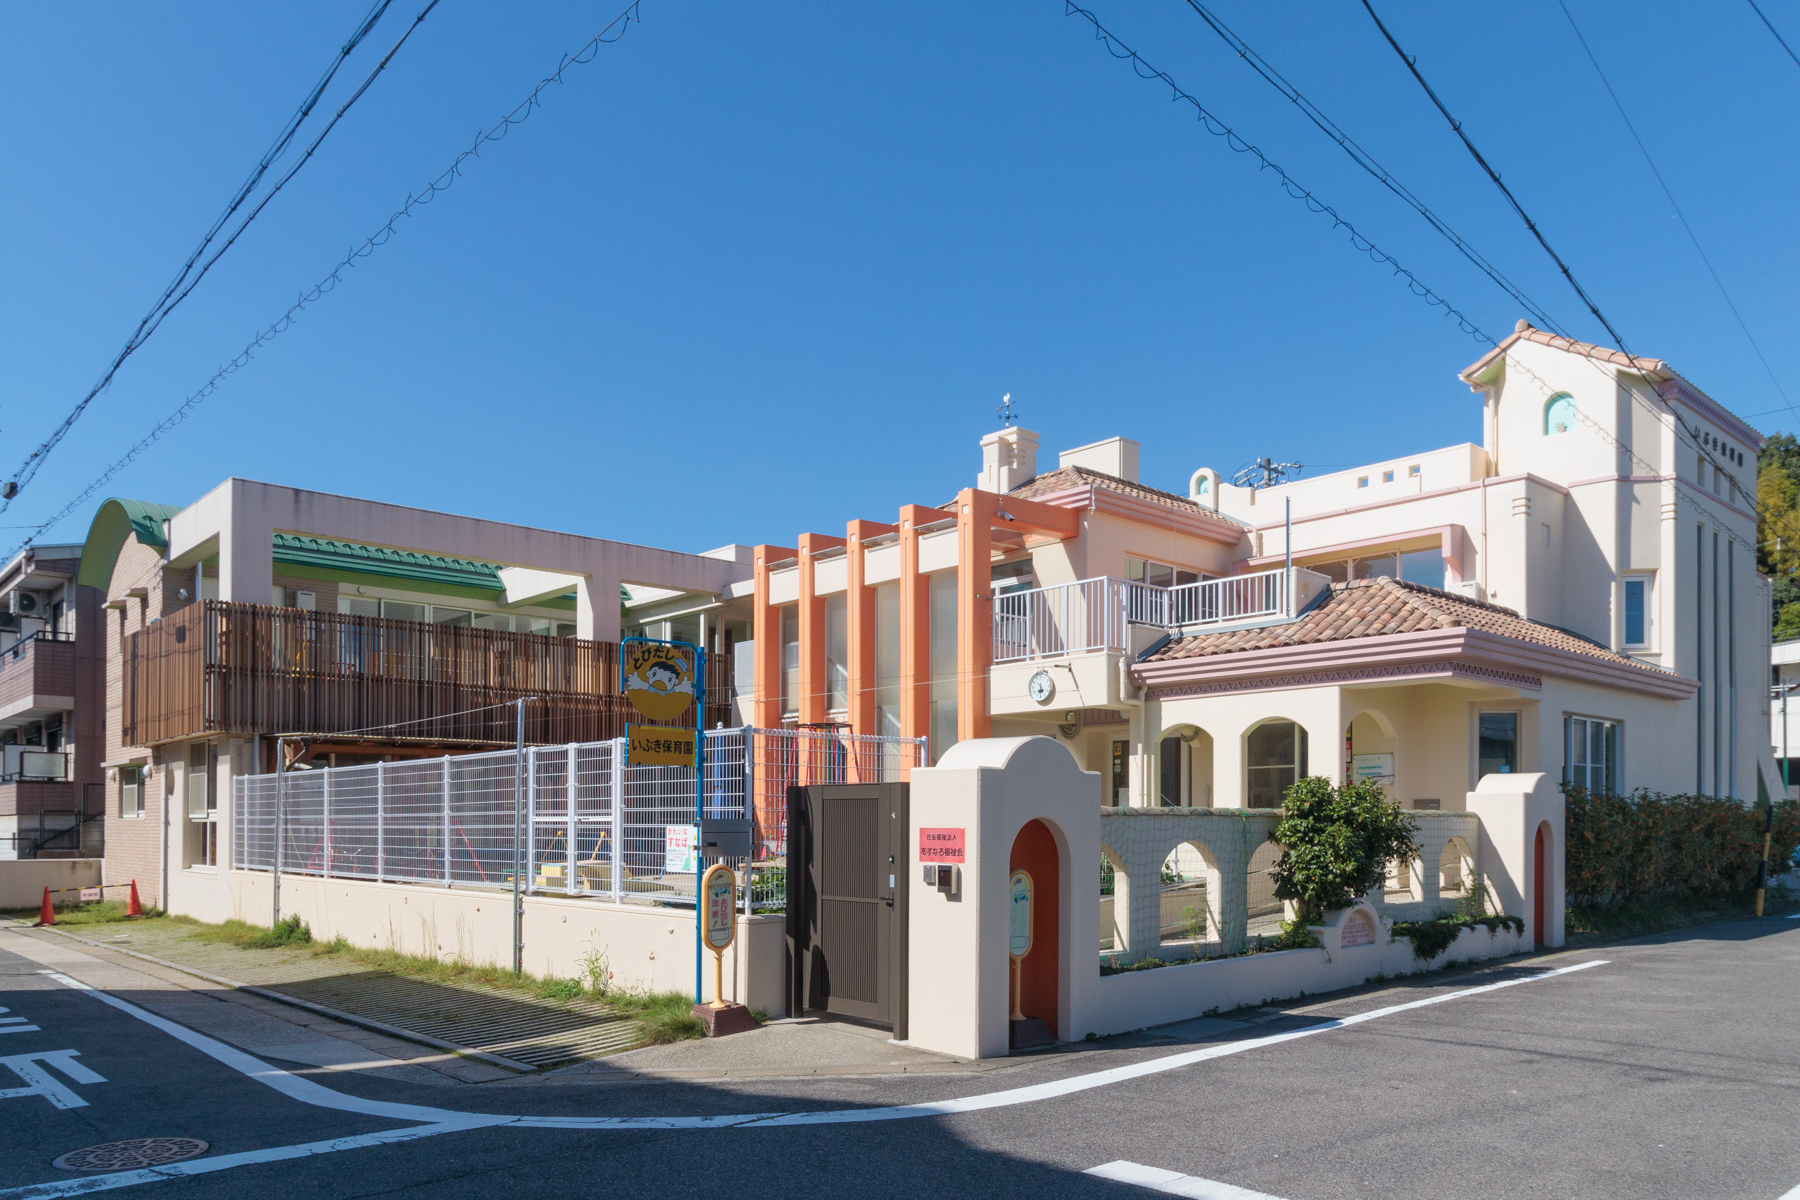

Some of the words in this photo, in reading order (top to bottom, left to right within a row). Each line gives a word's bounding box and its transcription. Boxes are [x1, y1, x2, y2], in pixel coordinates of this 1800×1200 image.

[1694, 426, 1743, 467] いぶき
[633, 647, 675, 670] とびだし
[632, 738, 694, 755] いぶき保育園
[668, 837, 688, 848] すなば
[921, 847, 963, 857] あすなろ福祉会
